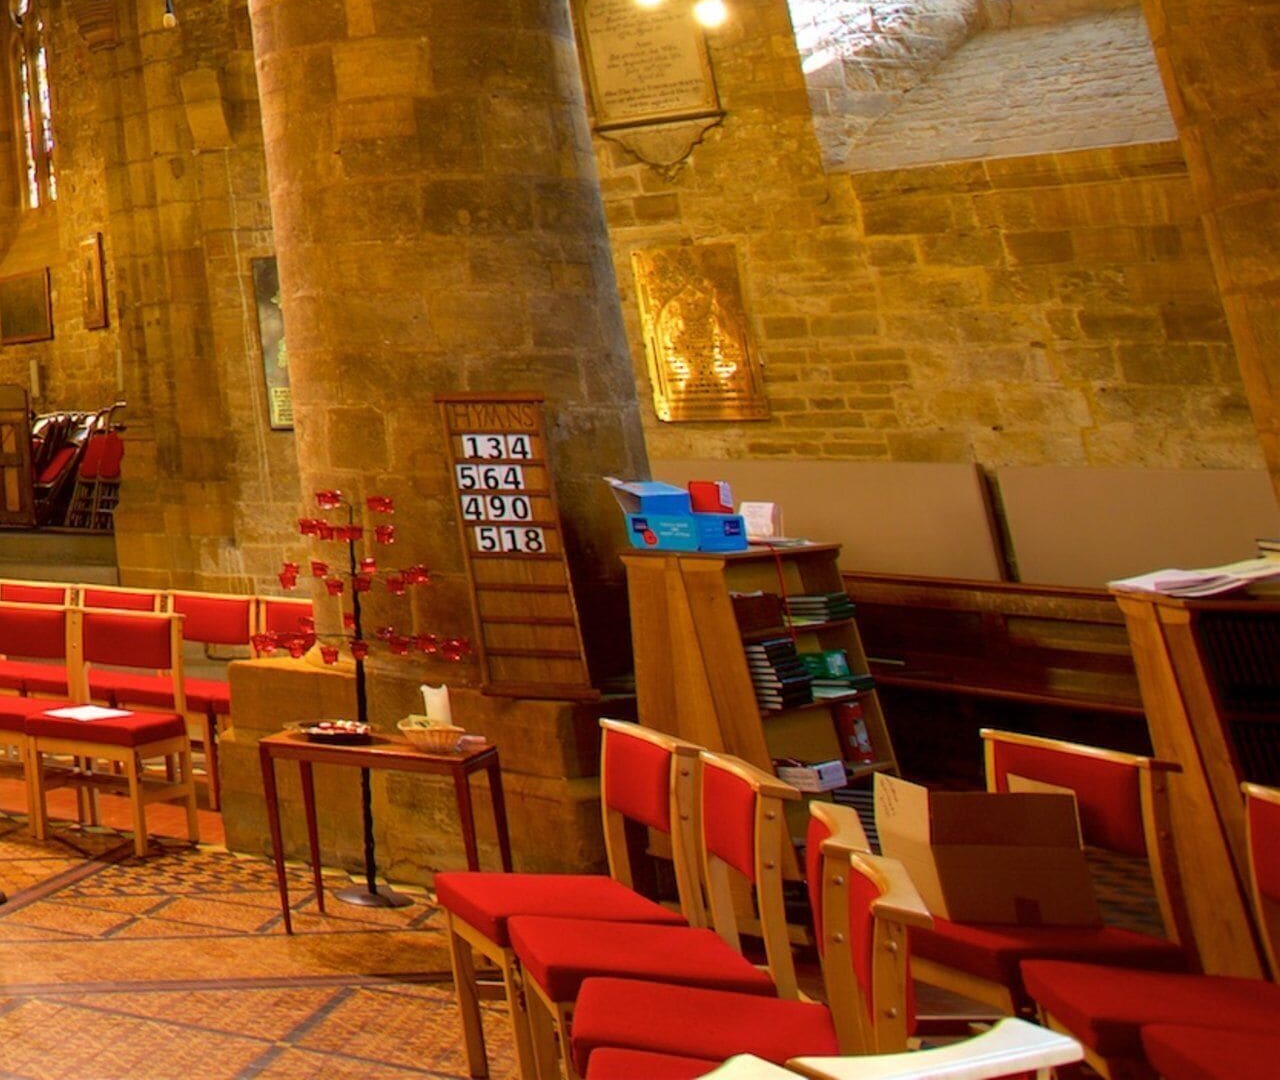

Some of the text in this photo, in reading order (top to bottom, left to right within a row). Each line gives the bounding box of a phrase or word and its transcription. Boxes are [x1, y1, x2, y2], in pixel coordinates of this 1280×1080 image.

[452, 404, 535, 428] HYMNS
[466, 436, 529, 459] 134
[460, 466, 521, 490] 564
[465, 495, 528, 520] 490
[480, 528, 542, 552] 518
